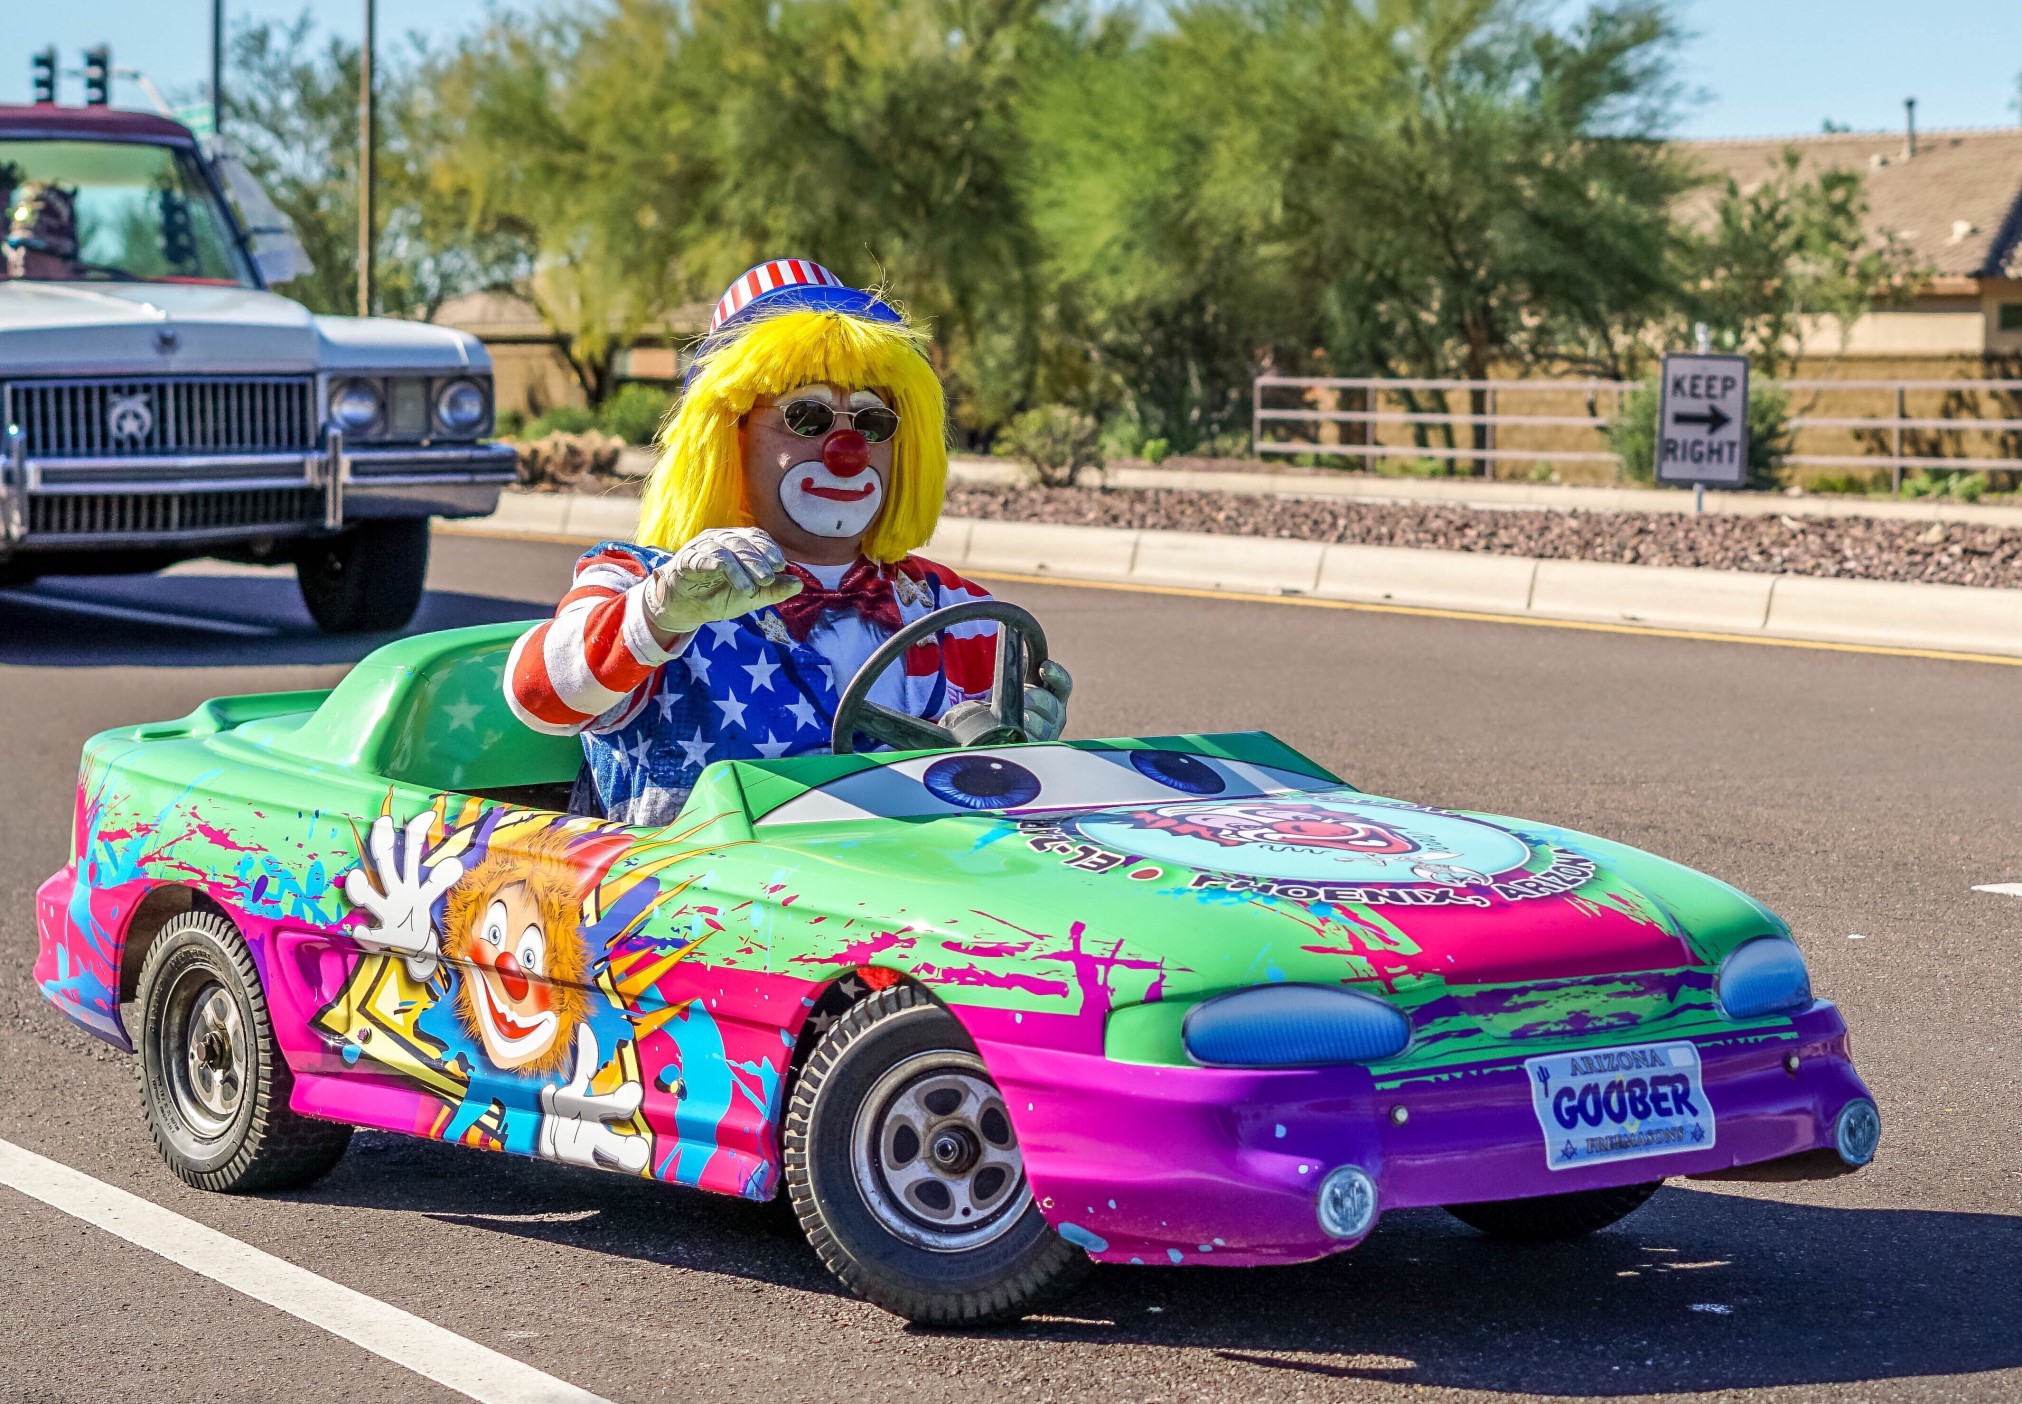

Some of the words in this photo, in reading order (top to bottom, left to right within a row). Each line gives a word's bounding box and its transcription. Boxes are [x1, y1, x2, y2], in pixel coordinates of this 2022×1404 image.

[1671, 373, 1737, 400] KEEP
[1662, 438, 1738, 464] RIGHT
[1570, 1049, 1666, 1077] ARIZONA
[1552, 1072, 1699, 1130] GOOBER
[1585, 1125, 1686, 1154] FREEMASONS
